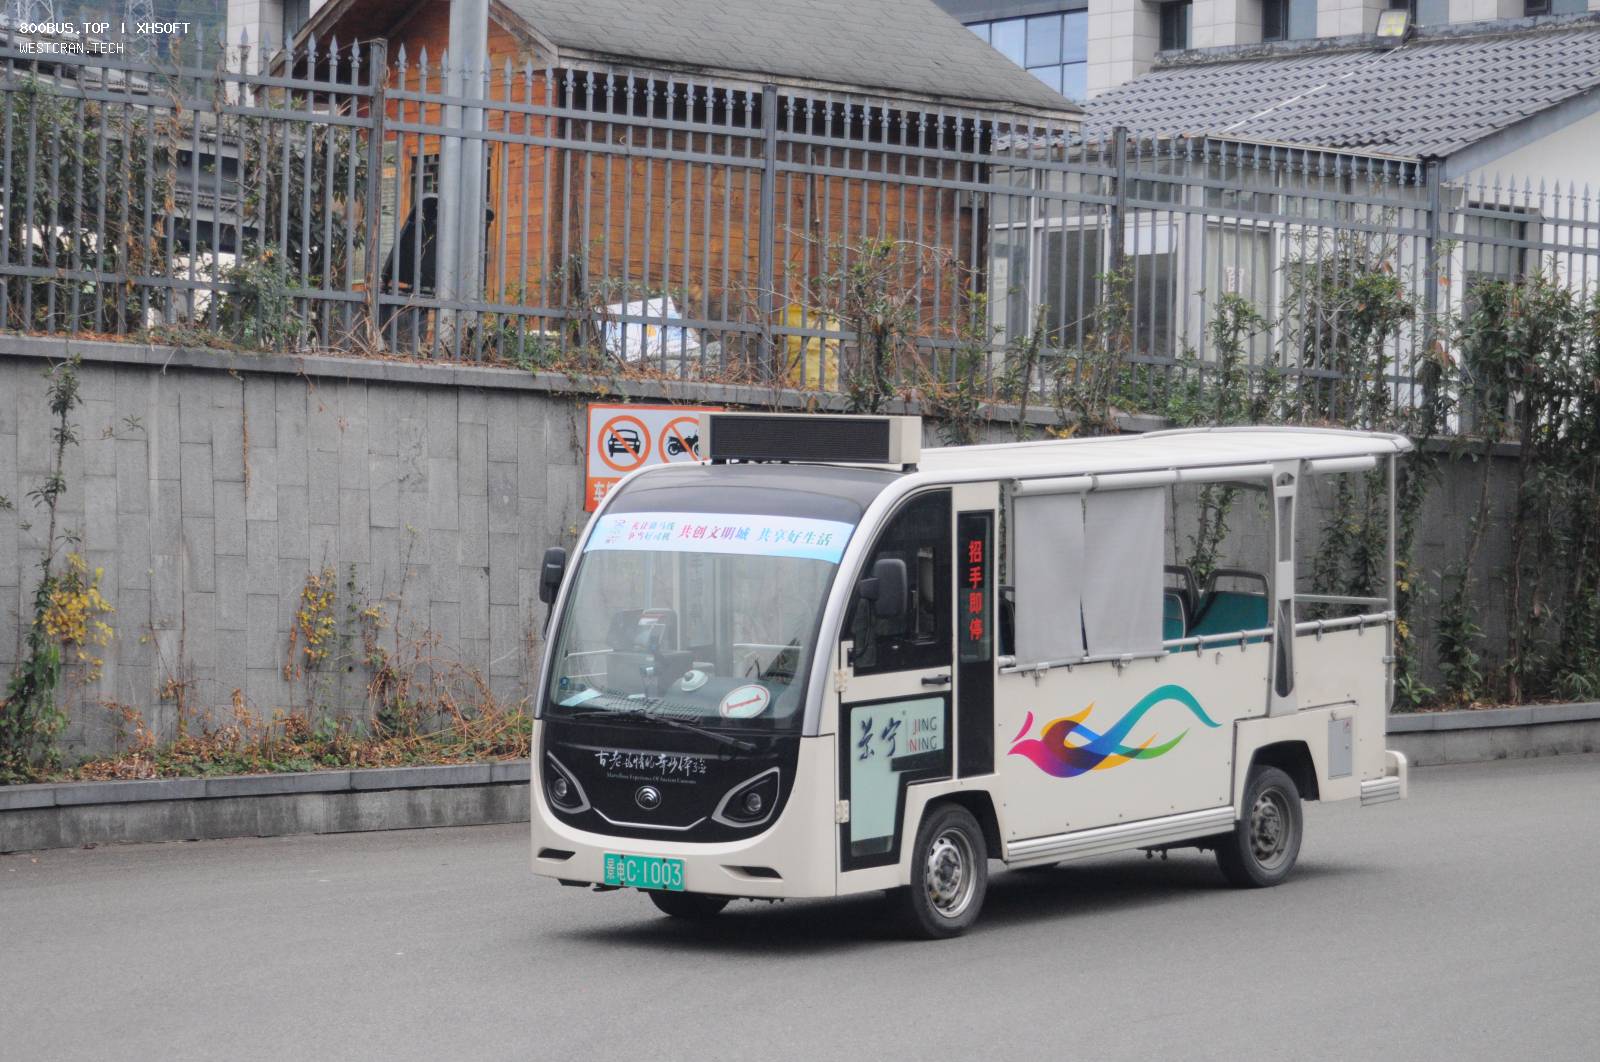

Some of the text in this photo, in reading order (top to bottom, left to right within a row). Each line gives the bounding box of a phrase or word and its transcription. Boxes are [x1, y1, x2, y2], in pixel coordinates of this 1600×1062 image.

[679, 524, 833, 546] 共创文明城 共享好生活
[968, 540, 983, 640] 招手即停
[912, 716, 938, 735] JING
[908, 735, 938, 753] NING
